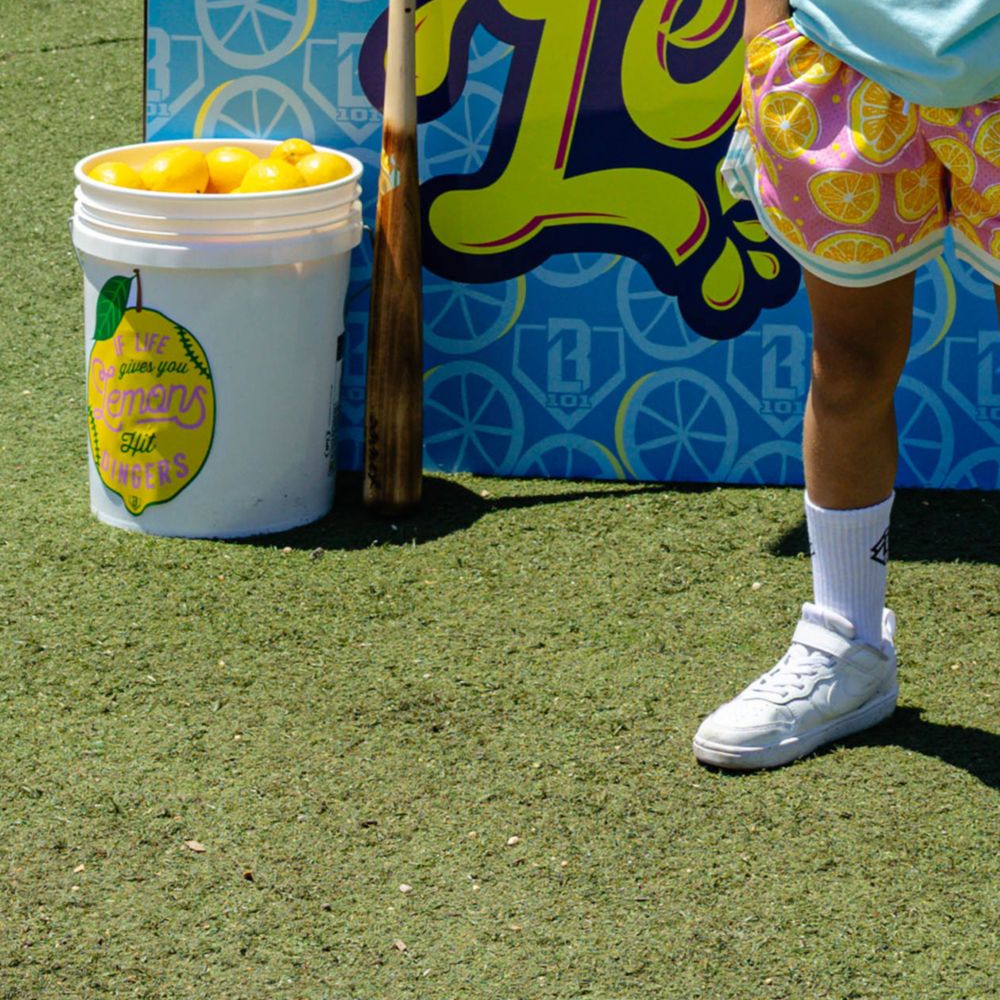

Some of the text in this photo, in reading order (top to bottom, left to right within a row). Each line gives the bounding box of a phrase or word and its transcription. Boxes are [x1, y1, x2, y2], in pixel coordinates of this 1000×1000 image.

[113, 332, 170, 357] IF LIFE
[118, 359, 190, 380] gives you
[92, 357, 207, 433] Lemons
[120, 432, 157, 457] Hit
[100, 452, 190, 490] DINGERS
